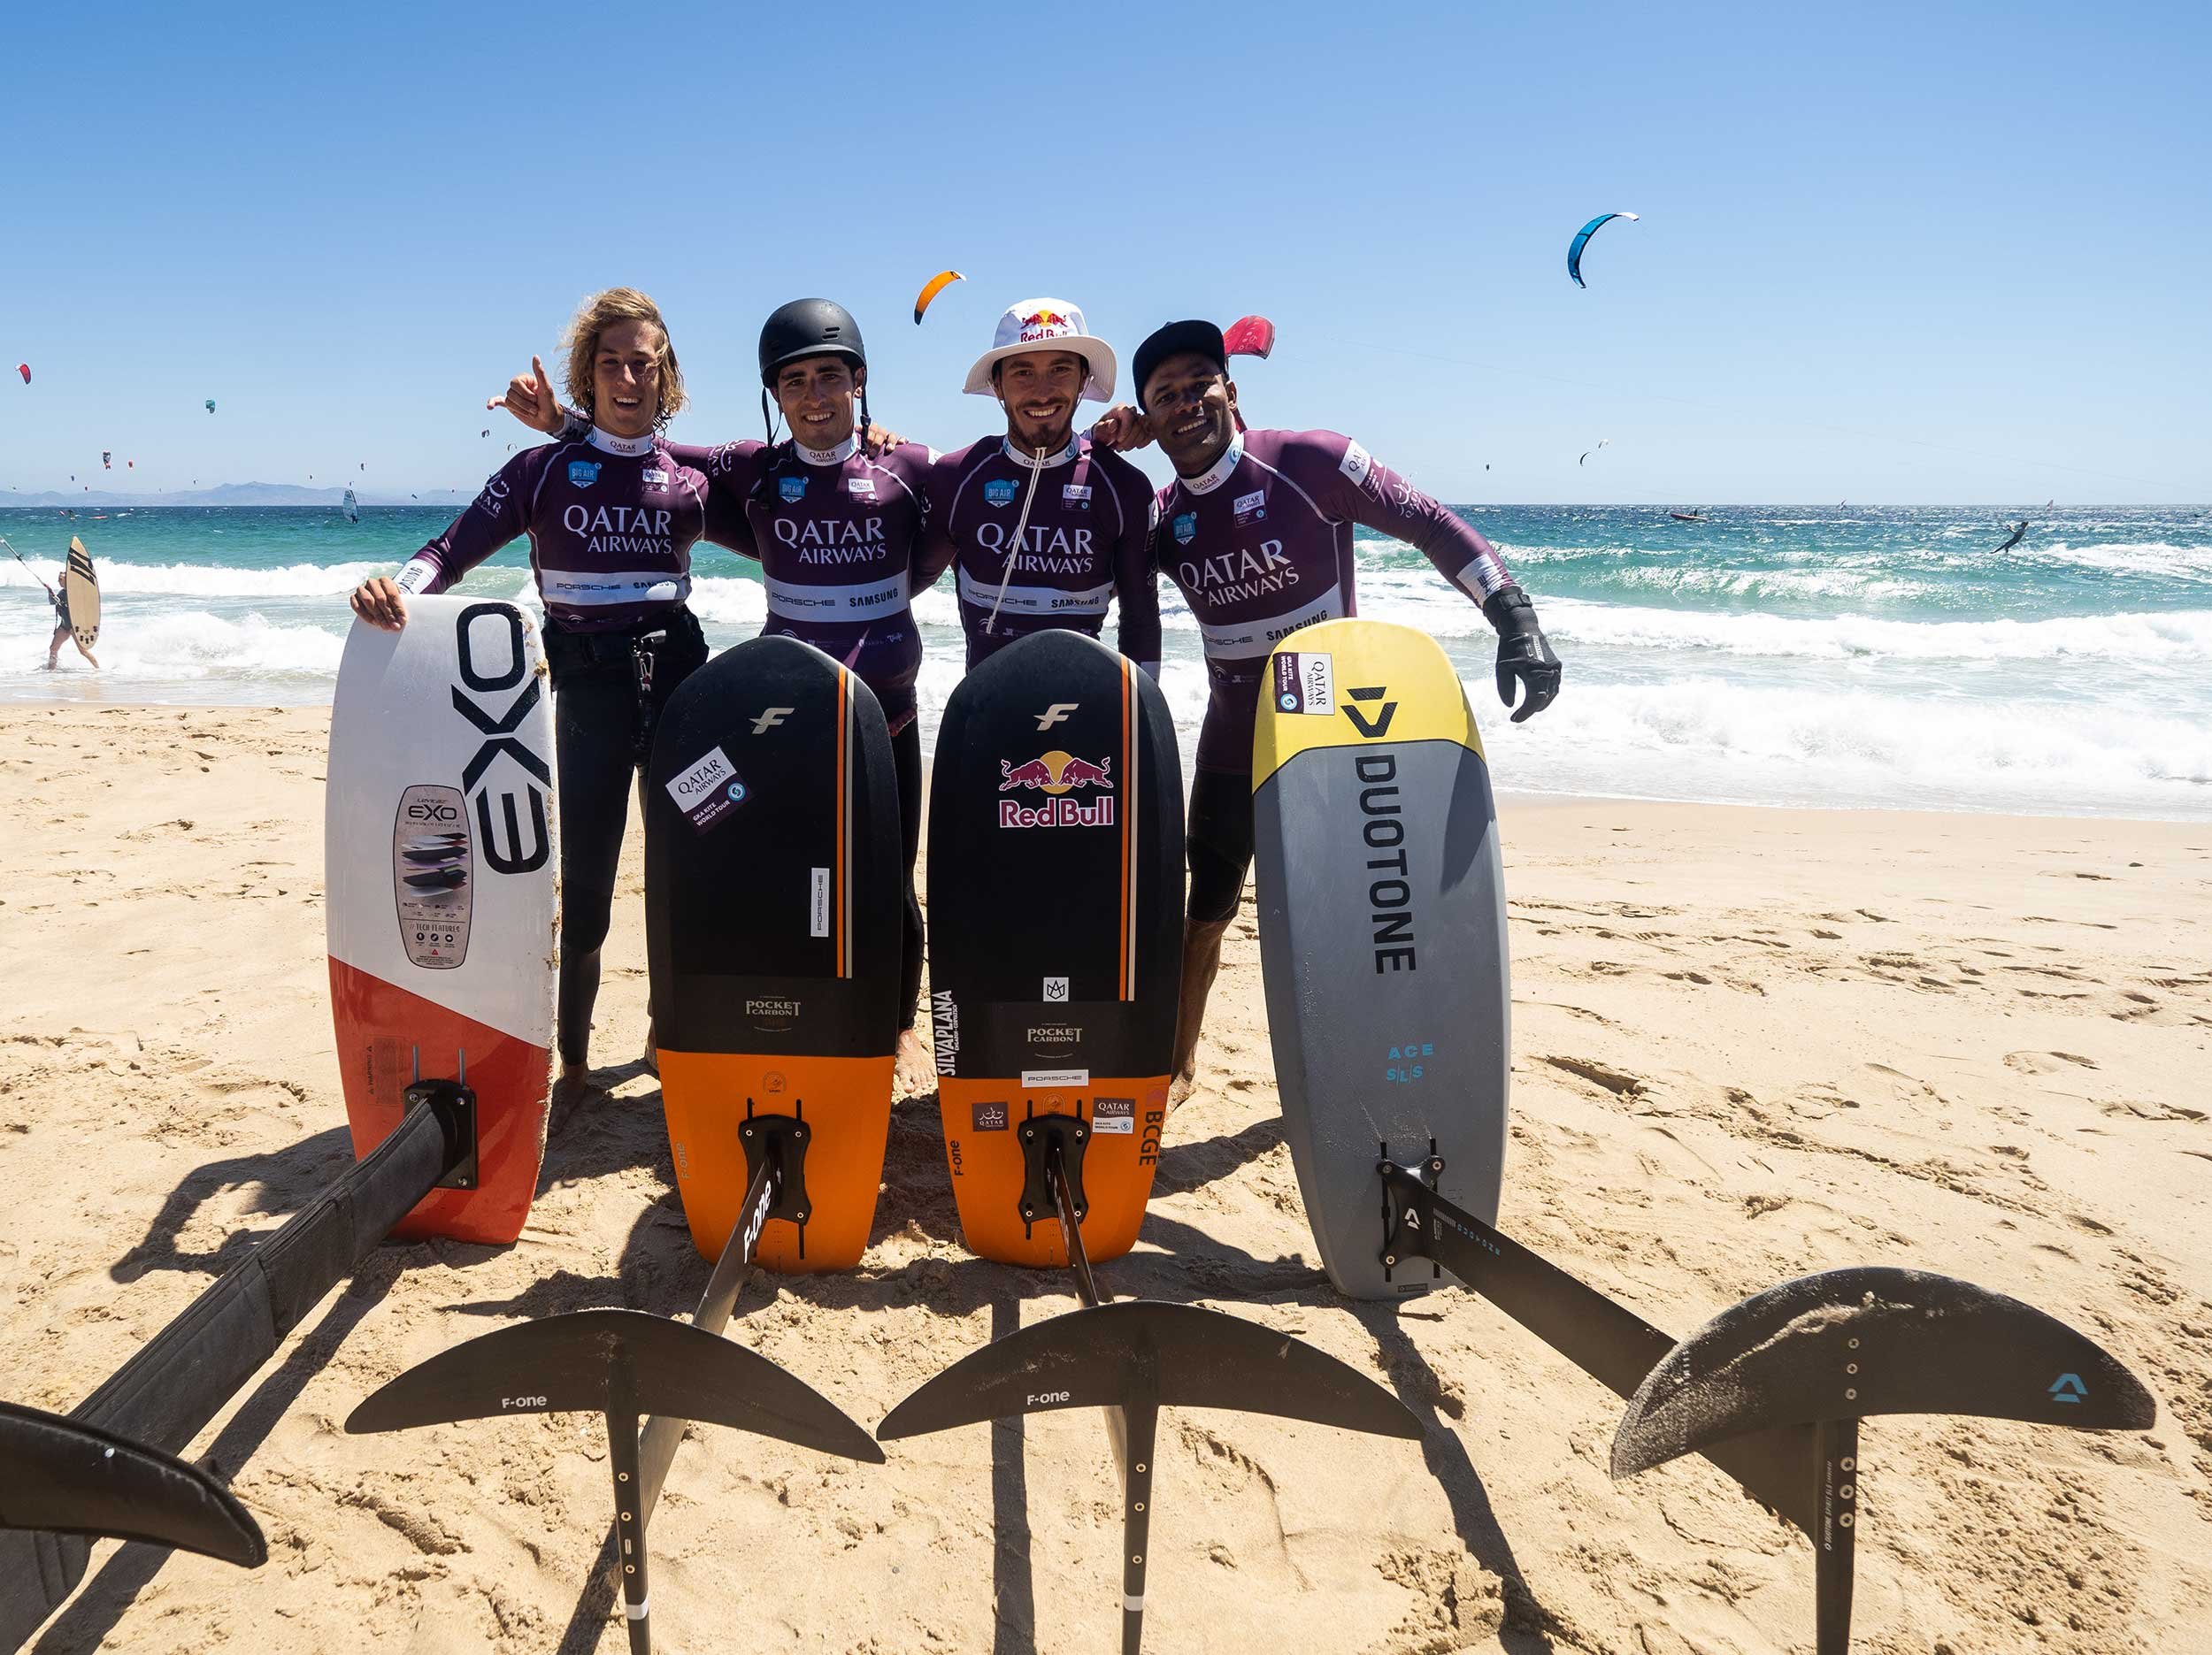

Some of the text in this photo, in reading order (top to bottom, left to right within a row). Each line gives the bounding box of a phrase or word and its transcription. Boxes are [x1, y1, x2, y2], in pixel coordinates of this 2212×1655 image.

[610, 441, 636, 451] QATAR
[810, 450, 836, 459] QATAR
[572, 469, 584, 478] BIG
[1194, 473, 1218, 490] QATAR
[988, 488, 1011, 497] BIG AIR
[1065, 487, 1088, 495] QATAR
[1236, 495, 1261, 508] QATAR
[564, 505, 672, 538] QATAR
[774, 517, 886, 549] QATAR
[976, 523, 1094, 555] QATAR
[588, 536, 672, 554] AIRWAYS
[798, 543, 887, 564] AIRWAYS
[1002, 554, 1094, 573] AIRWAYS
[1179, 539, 1292, 595] QATAR
[557, 582, 621, 591] PORSCHE
[1208, 566, 1300, 607] AIRWAYS
[772, 588, 899, 608] PORSCHE SAMSUNG
[1051, 596, 1100, 609] SAMSUNG
[1266, 609, 1327, 641] SAMSUNG
[1306, 672, 1315, 706] AIRWAYS
[1311, 661, 1326, 706] QATAR
[451, 602, 553, 874] EXO
[678, 759, 722, 794] QATAR
[695, 768, 726, 795] AIRWAYS
[409, 804, 457, 822] EXO
[693, 802, 717, 822] GKA KITE
[696, 800, 731, 827] WORLD TOUR
[999, 796, 1114, 828] Red Bull
[1355, 755, 1417, 974] DUOTONE
[746, 1000, 802, 1016] POCKET
[932, 990, 956, 1076] SILVAPLANA
[1027, 1028, 1083, 1042] POCKET
[1388, 1044, 1433, 1060] ACE
[1098, 1102, 1130, 1111] QATAR
[1139, 1111, 1164, 1166] BCGE
[950, 1140, 964, 1176] F-one
[744, 1180, 771, 1264] F-one
[502, 1396, 547, 1408] F-one
[1027, 1391, 1070, 1406] F-one
